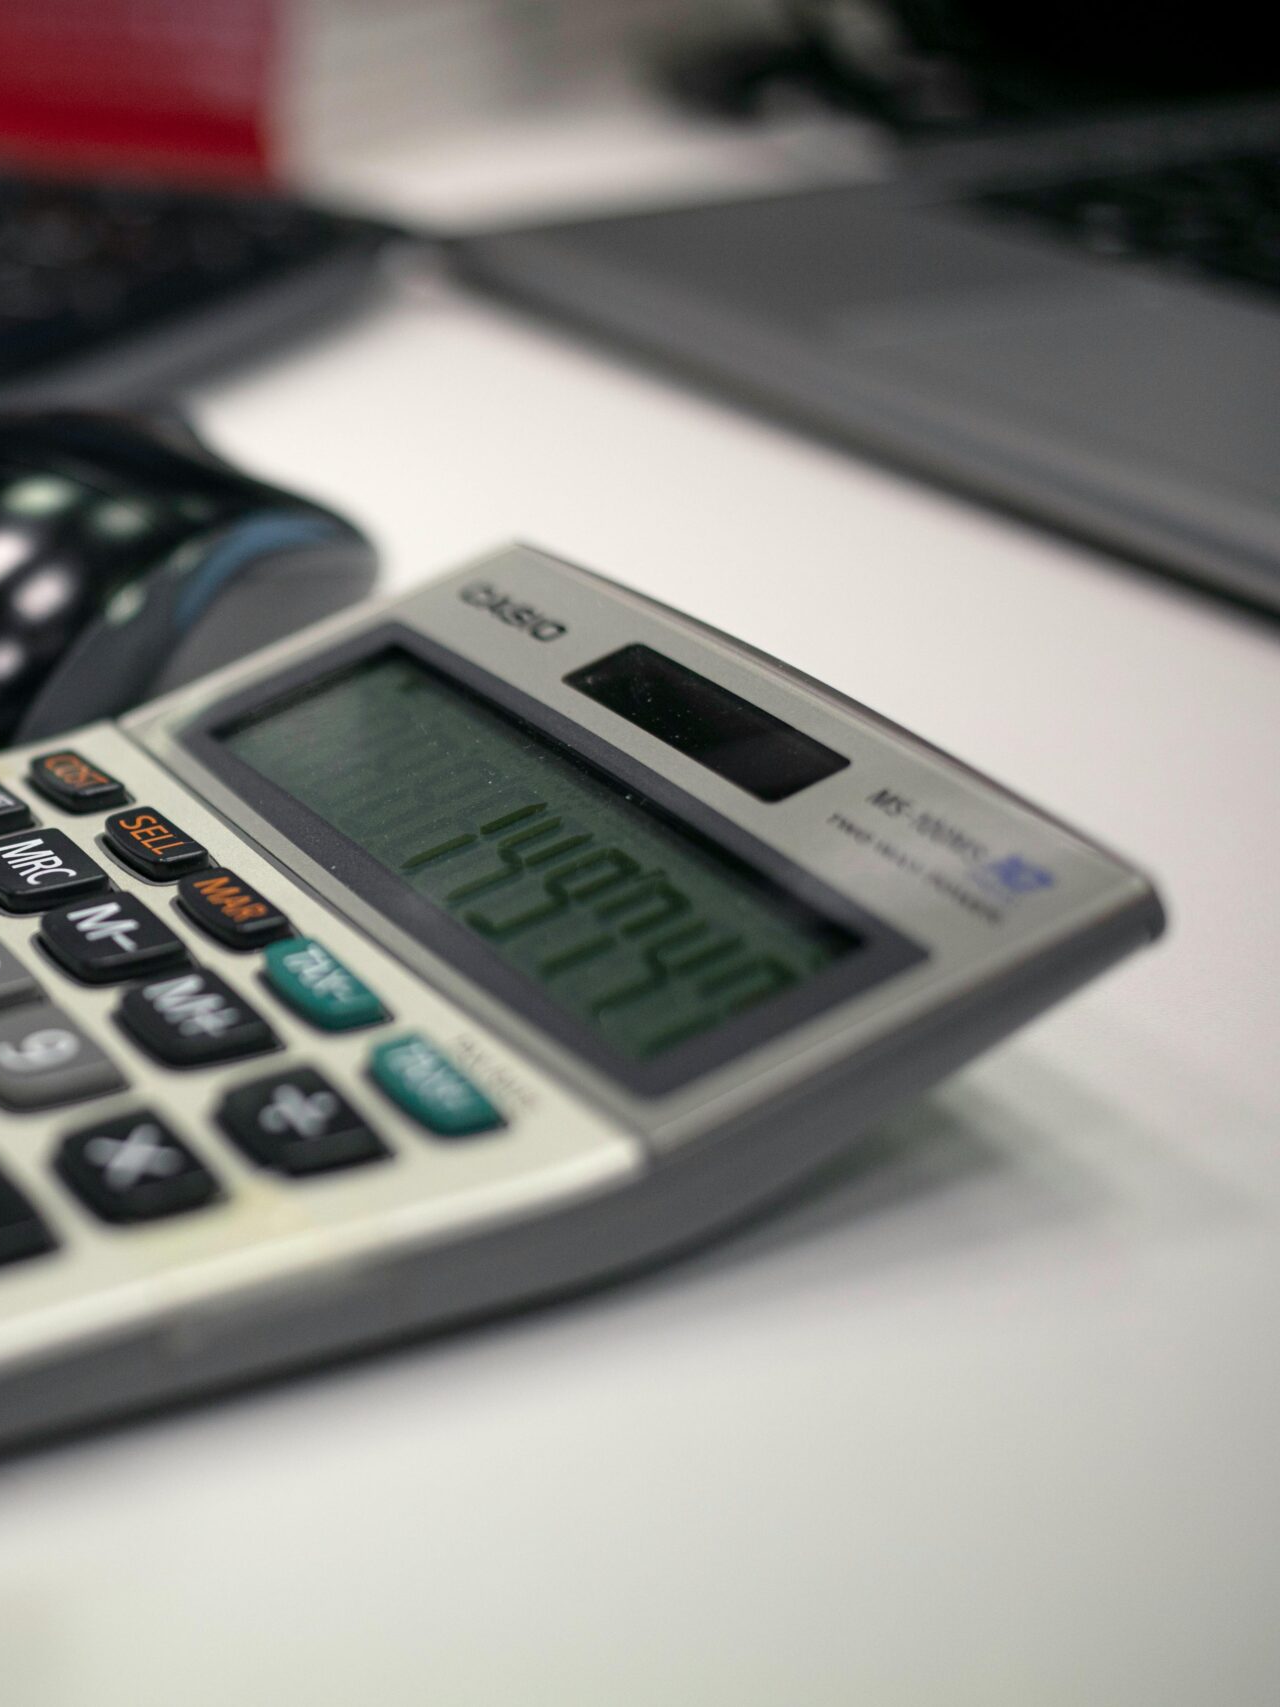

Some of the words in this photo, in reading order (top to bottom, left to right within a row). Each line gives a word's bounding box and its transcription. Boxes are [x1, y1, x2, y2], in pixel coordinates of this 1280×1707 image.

[460, 579, 567, 642] CASIO
[44, 755, 109, 790] COST
[119, 814, 185, 855] SELL
[194, 876, 268, 922] MAR
[67, 902, 139, 952] M-
